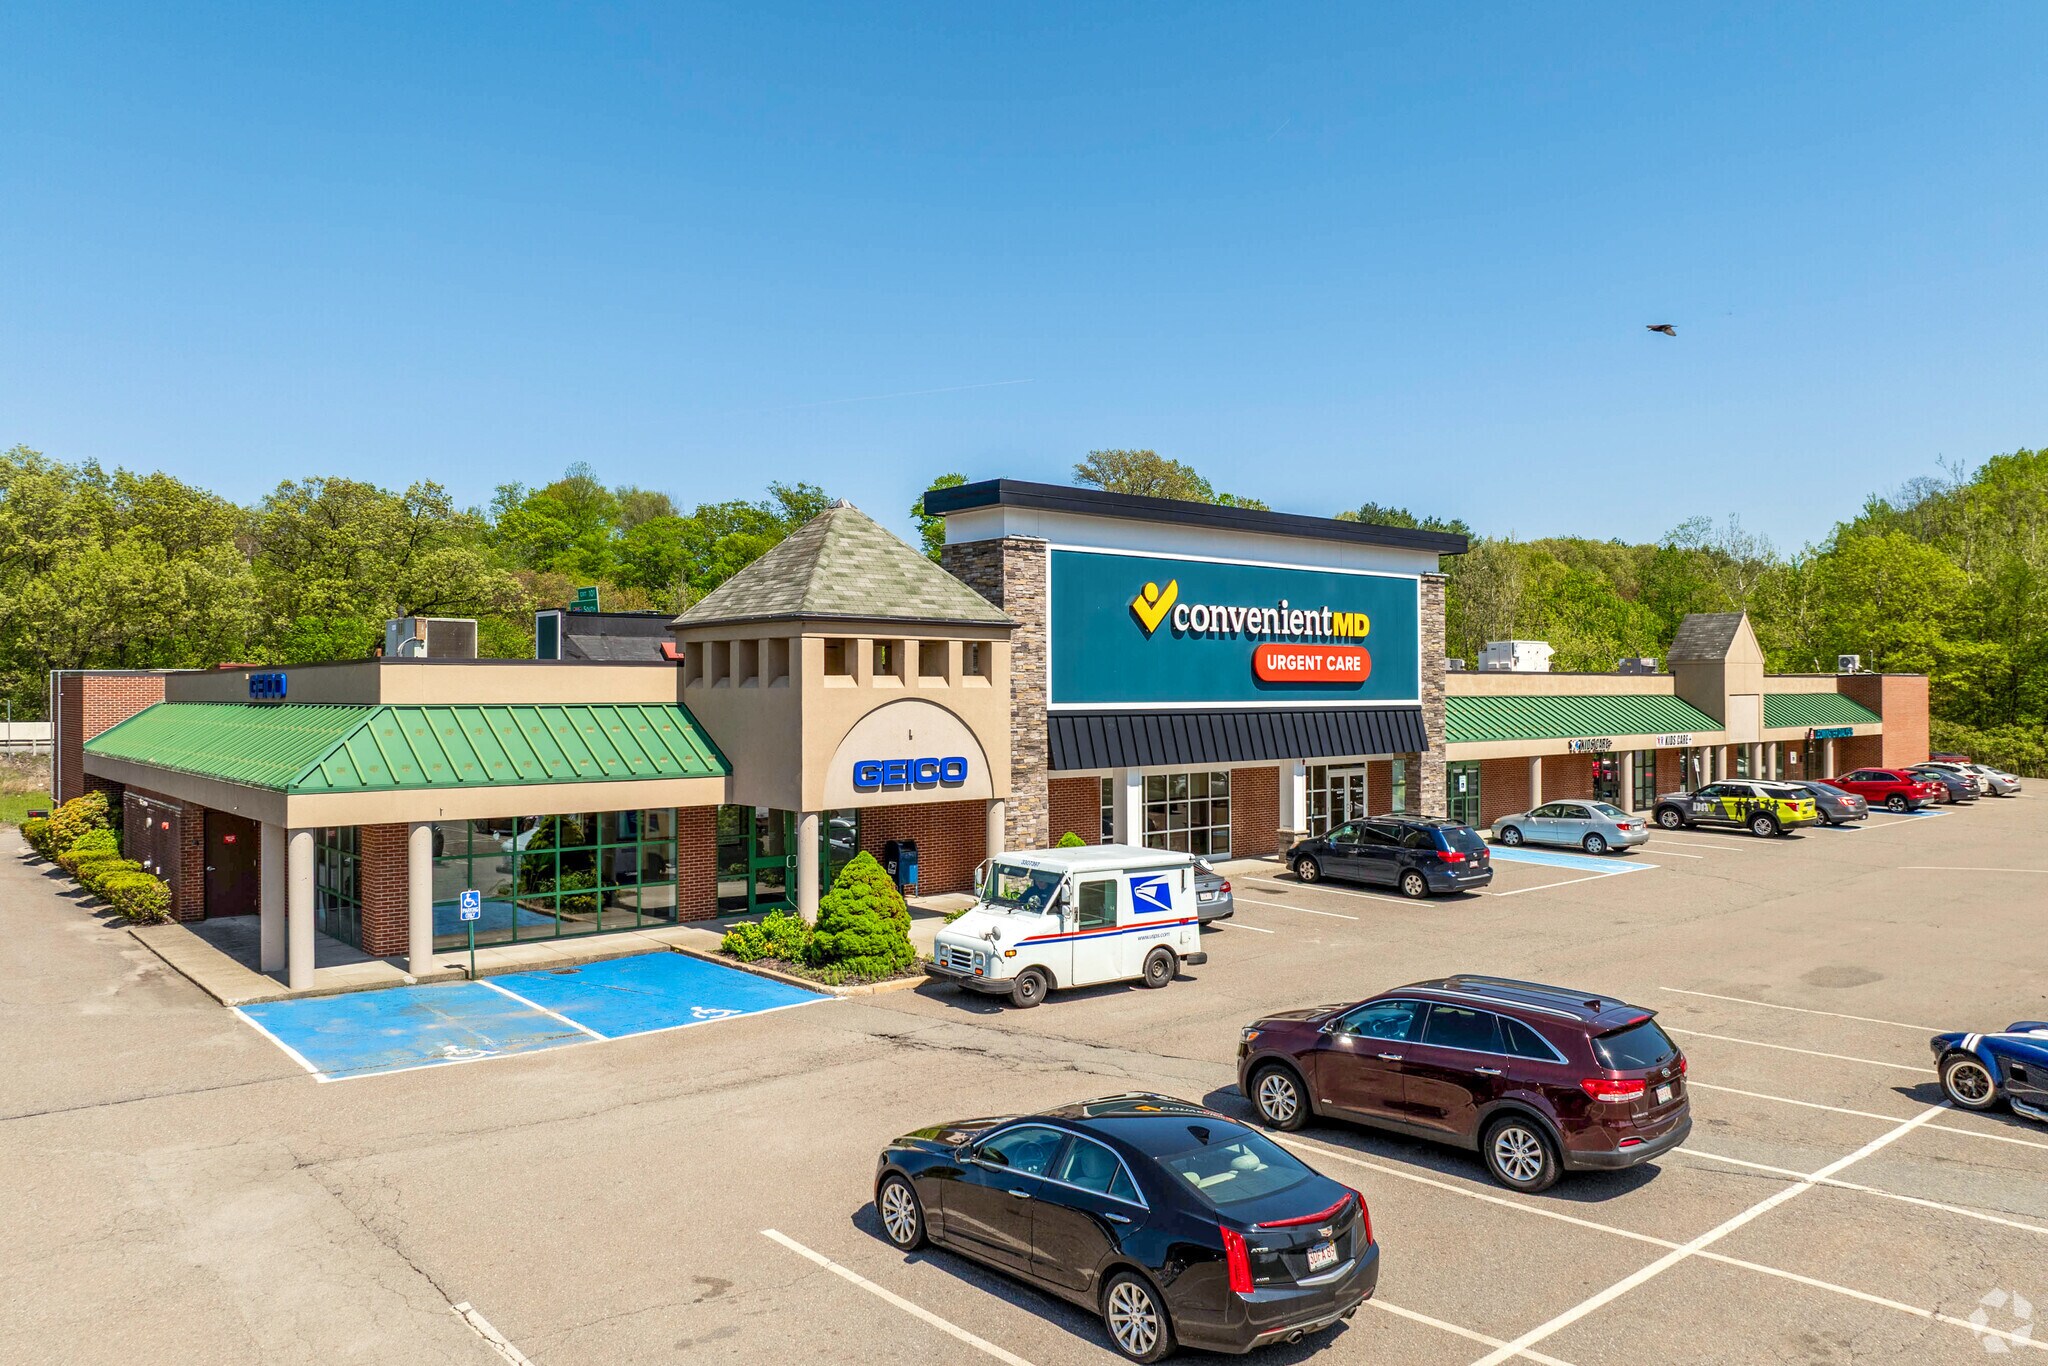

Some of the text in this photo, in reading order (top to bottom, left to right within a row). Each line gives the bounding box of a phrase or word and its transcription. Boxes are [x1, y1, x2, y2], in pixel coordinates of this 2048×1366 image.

[1173, 600, 1371, 637] convenientMD
[1266, 654, 1361, 671] URGENT CARE
[1665, 736, 1676, 746] KIDS
[853, 757, 968, 787] GEICO
[1692, 802, 1717, 813] DAV
